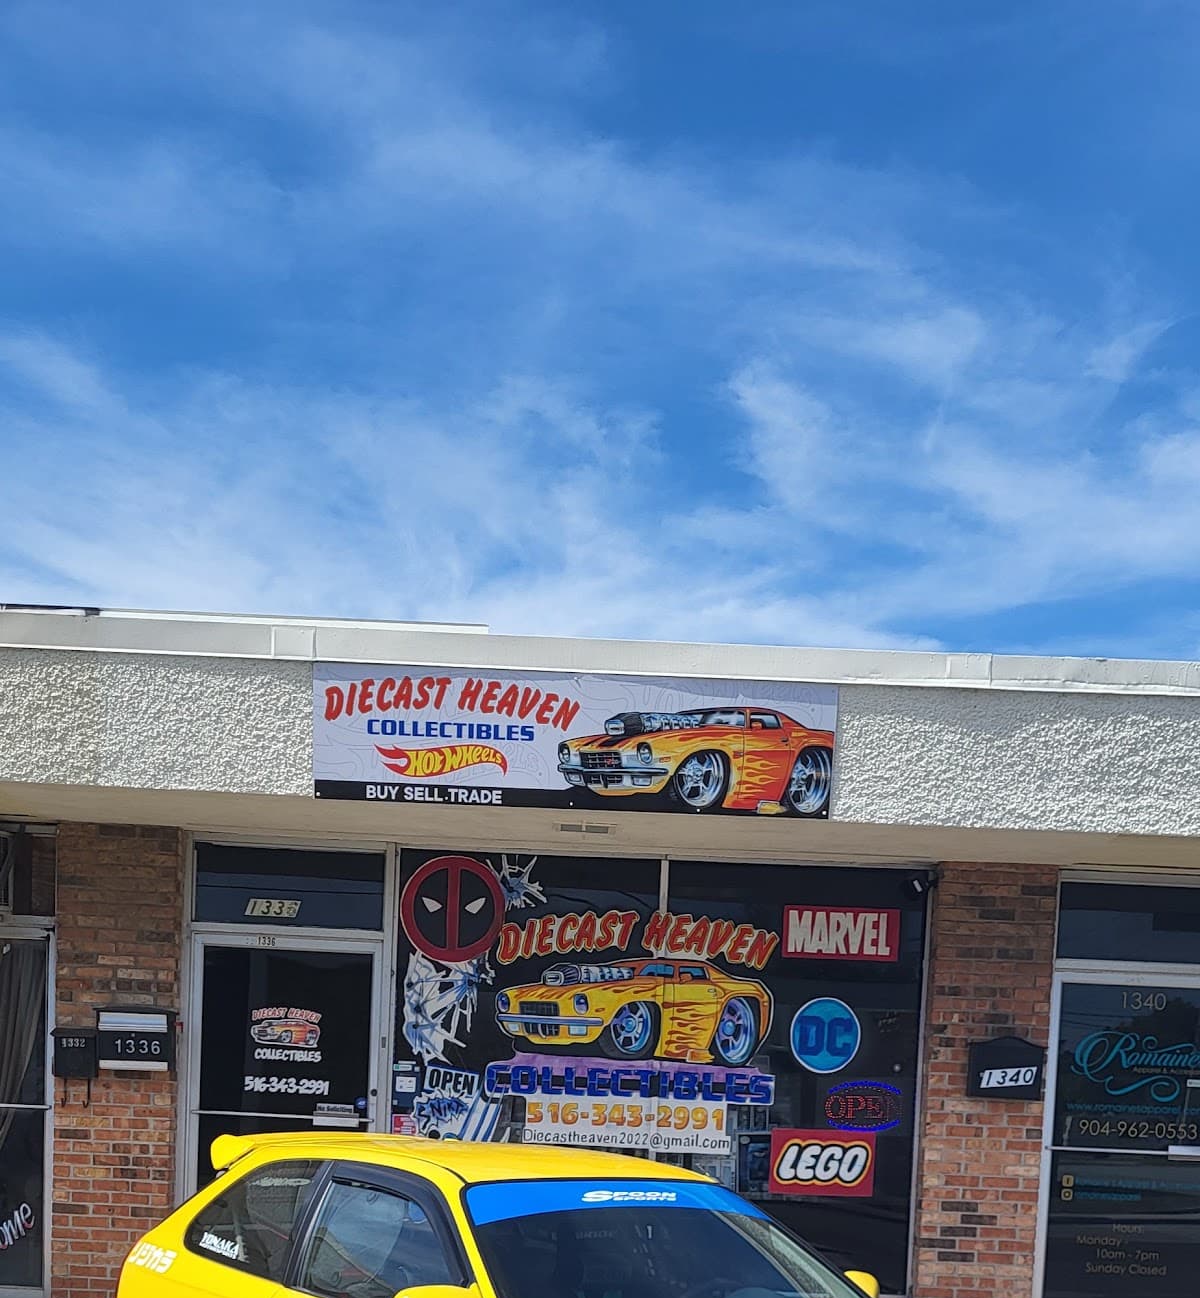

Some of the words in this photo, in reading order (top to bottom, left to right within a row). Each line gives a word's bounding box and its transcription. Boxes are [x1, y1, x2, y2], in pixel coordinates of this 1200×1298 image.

[324, 676, 451, 721] DIECAST
[457, 677, 580, 731] HEAVEN
[367, 719, 535, 741] COLLECTIBLES
[366, 784, 399, 800] BUY
[257, 936, 276, 947] 1336
[498, 910, 641, 964] DIECAST
[641, 910, 780, 970] HEAVEN
[787, 909, 891, 956] MARVEL
[1121, 991, 1167, 1011] 1340
[252, 1007, 287, 1021] DIECAST
[287, 1008, 322, 1023] HEAVEN
[114, 1039, 161, 1055] 1336
[799, 1015, 854, 1058] DC
[254, 1048, 322, 1062] COLLECTIBLES
[244, 1076, 330, 1096] 516-343-2991
[428, 1069, 475, 1095] OPEN
[485, 1064, 776, 1105] COLLECTIBLES
[986, 1069, 1034, 1086] 1340
[527, 1101, 725, 1131] 516-343-2991
[523, 1128, 730, 1150] Diecastheaven2022@gmail.com
[1079, 1119, 1199, 1141] 904-962-0553
[778, 1145, 868, 1185] LEGO
[581, 1190, 677, 1202] SPOON
[1077, 1235, 1122, 1247] Monday
[1086, 1262, 1127, 1275] Sunday
[1128, 1263, 1168, 1277] Closed
